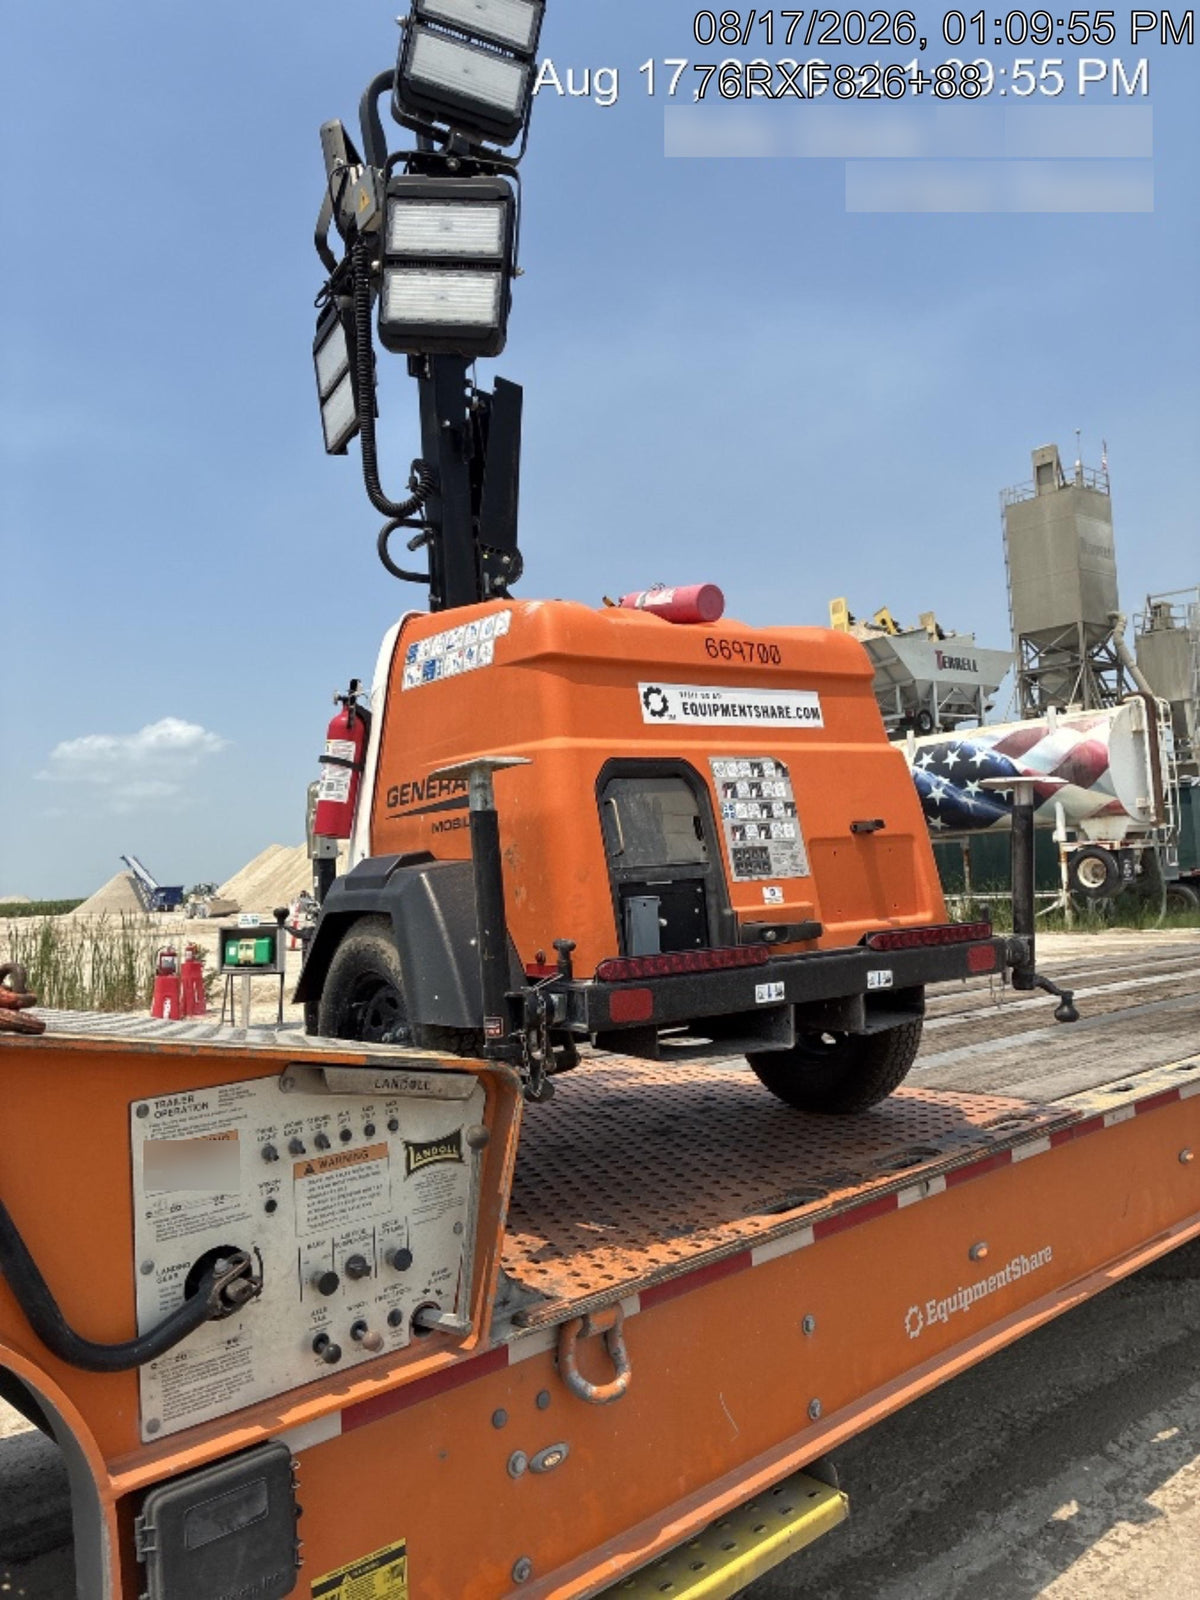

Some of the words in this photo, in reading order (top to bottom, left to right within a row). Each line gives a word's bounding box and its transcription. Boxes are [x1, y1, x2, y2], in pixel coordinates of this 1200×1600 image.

[705, 637, 781, 665] 669700
[682, 701, 821, 721] EQUIPMENTSHARE.COM
[386, 779, 468, 808] GENERA
[431, 816, 470, 834] MOBIL
[408, 1145, 460, 1171] LANDOLL
[926, 1246, 1053, 1325] EquipmentShare
